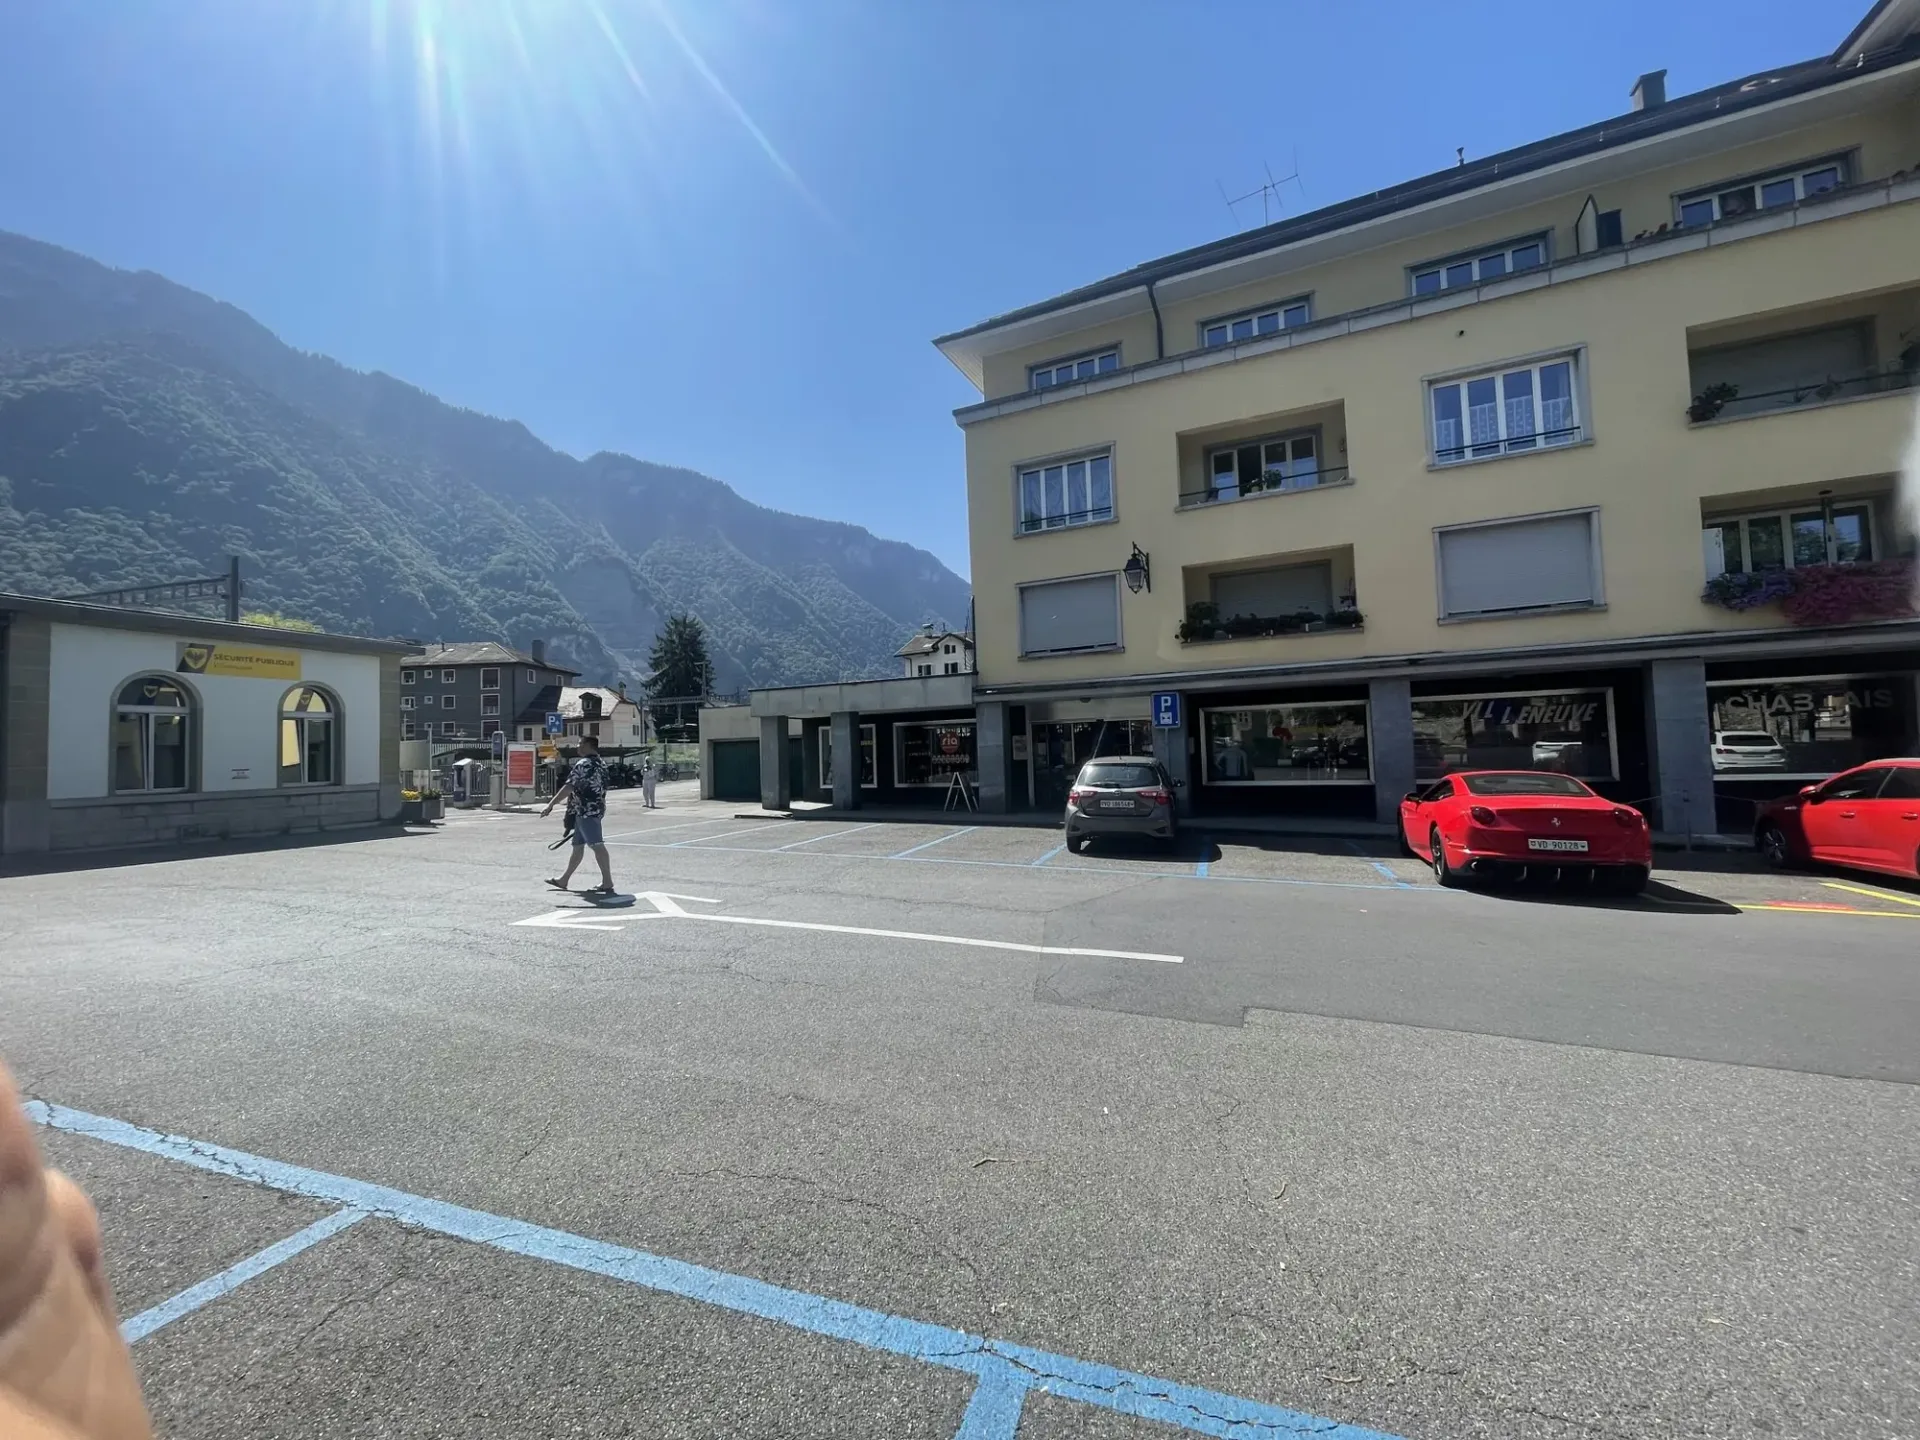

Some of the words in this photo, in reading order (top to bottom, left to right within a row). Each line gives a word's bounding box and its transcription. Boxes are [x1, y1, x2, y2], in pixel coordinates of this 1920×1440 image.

[255, 658, 295, 667] PUBLIQUE
[1161, 696, 1171, 711] P
[548, 716, 556, 726] P
[1552, 841, 1579, 849] 90128
